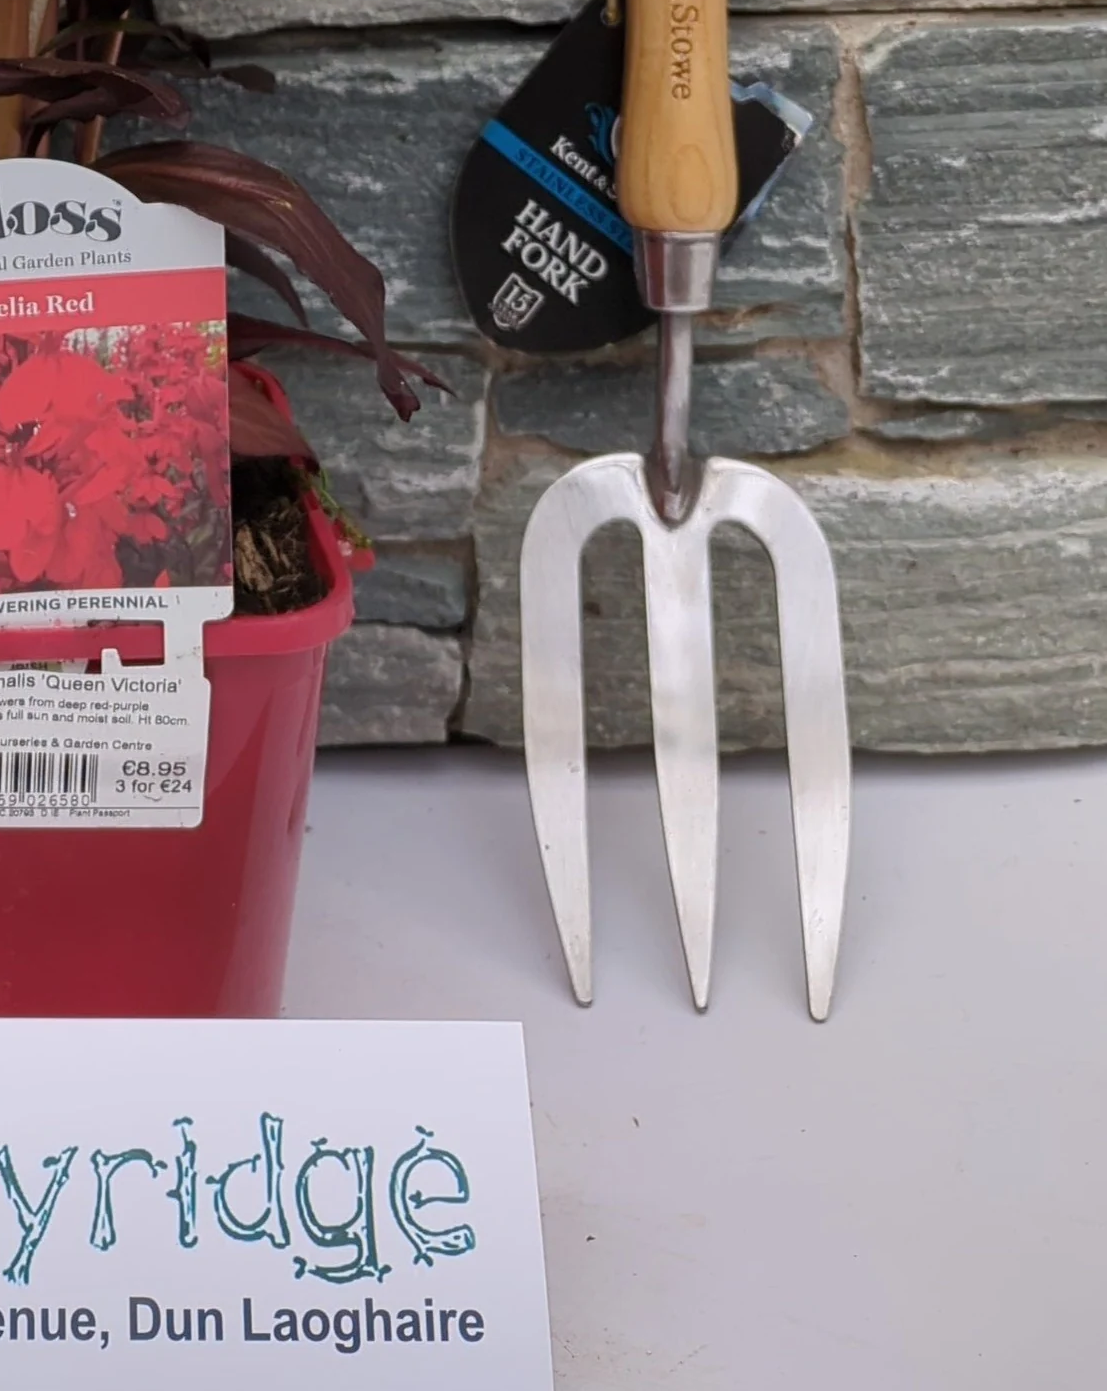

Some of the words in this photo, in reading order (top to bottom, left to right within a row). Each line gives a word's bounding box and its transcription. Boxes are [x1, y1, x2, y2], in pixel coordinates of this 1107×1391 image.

[550, 135, 598, 182] Kent
[516, 147, 607, 223] STAINLESS
[515, 199, 608, 281] HAND
[13, 253, 74, 270] Garden
[80, 250, 132, 265] Plants
[500, 225, 590, 306] FORK
[46, 292, 93, 313] Red
[67, 596, 169, 610] PERENNIAL
[42, 674, 105, 691] 'Queen
[111, 678, 182, 693] Victoria'
[28, 696, 54, 707] from
[59, 699, 86, 711] deep
[90, 701, 149, 712] red-purple
[6, 710, 24, 720] full
[27, 712, 49, 721] sun
[52, 712, 73, 722] and
[77, 713, 108, 723] moist
[138, 715, 151, 725] Ht
[51, 738, 59, 747] &
[63, 738, 108, 749] Garden
[112, 740, 152, 750] Centre
[122, 760, 186, 776] €8.95
[115, 779, 125, 792] 3
[132, 779, 155, 792] for
[160, 779, 192, 793] €24
[128, 1297, 224, 1341] Dun
[243, 1297, 485, 1353] Laoghaire
